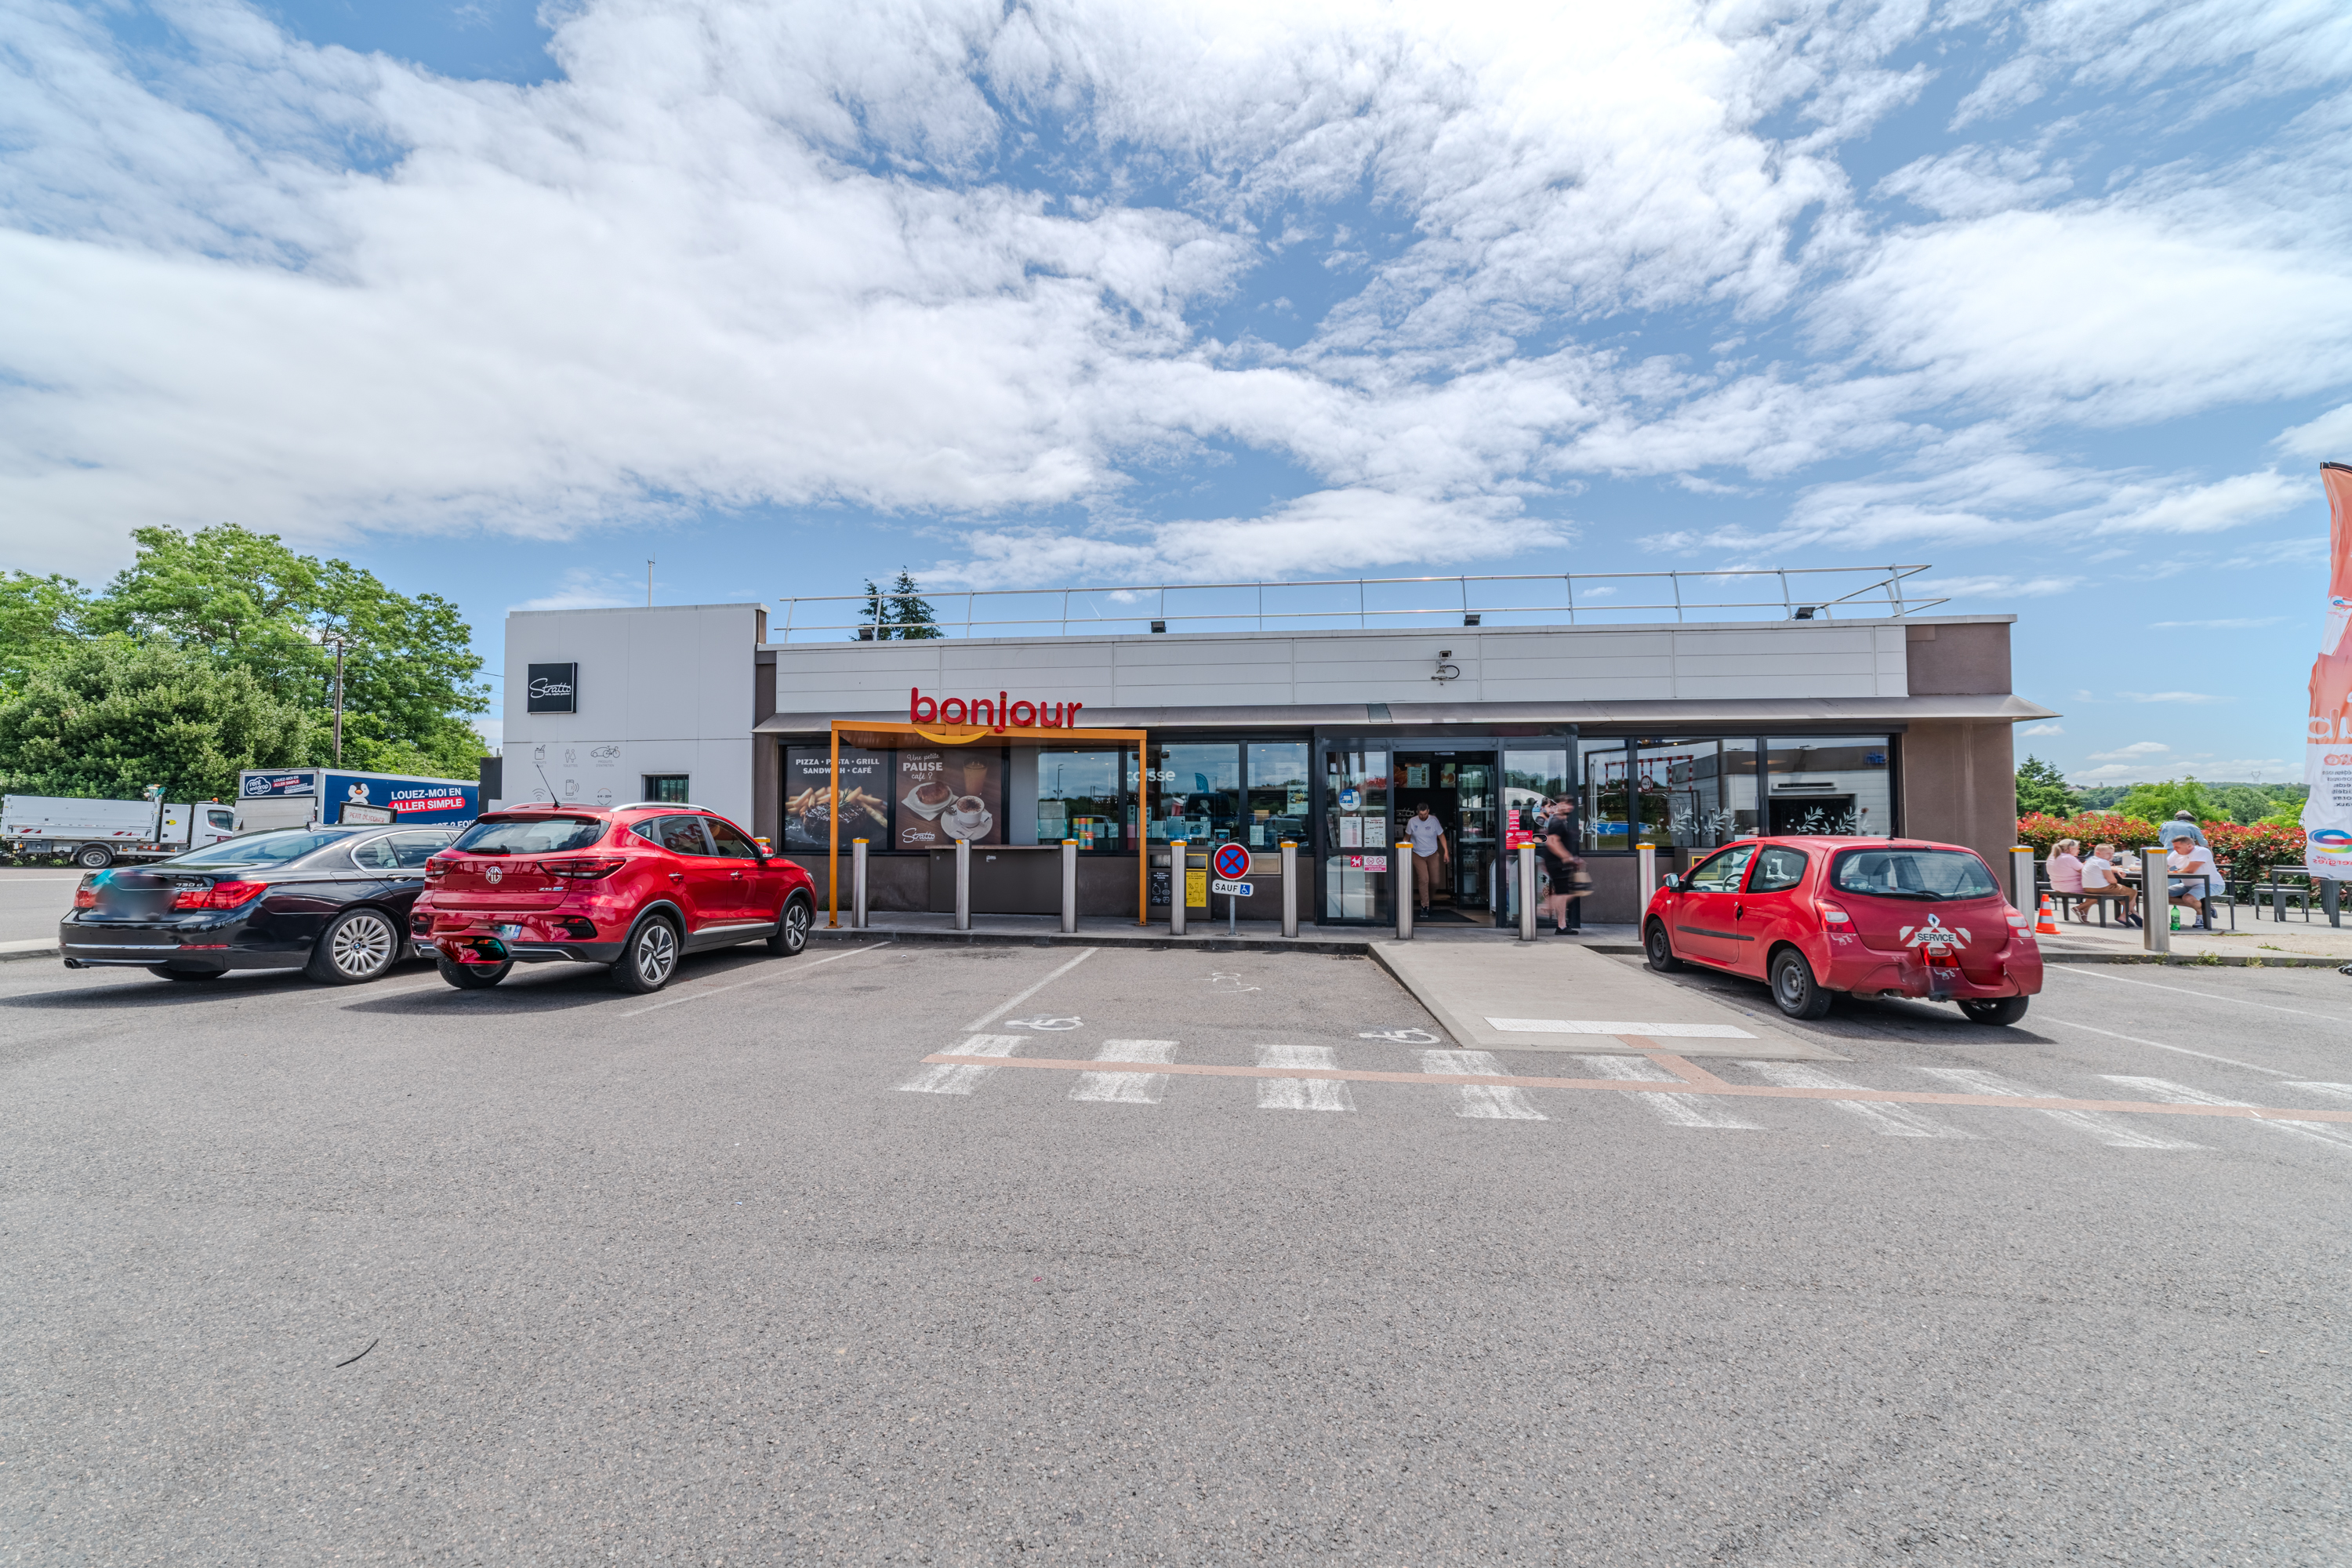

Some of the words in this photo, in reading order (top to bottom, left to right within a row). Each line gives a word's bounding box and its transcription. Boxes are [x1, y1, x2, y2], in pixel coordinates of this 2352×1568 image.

[529, 678, 571, 698] Stratto
[910, 687, 1083, 733] bonjour
[924, 753, 940, 762] petite
[903, 762, 943, 771] PAUSE
[911, 772, 925, 781] café
[391, 788, 447, 800] LOUEZ-MOI
[449, 788, 461, 796] EN
[393, 801, 425, 811] ALLER
[427, 798, 462, 809] SIMPLE
[902, 828, 935, 843] Stratto
[487, 867, 501, 883] MG
[1215, 883, 1238, 892] SAUF
[1917, 933, 1955, 942] SERVICE
